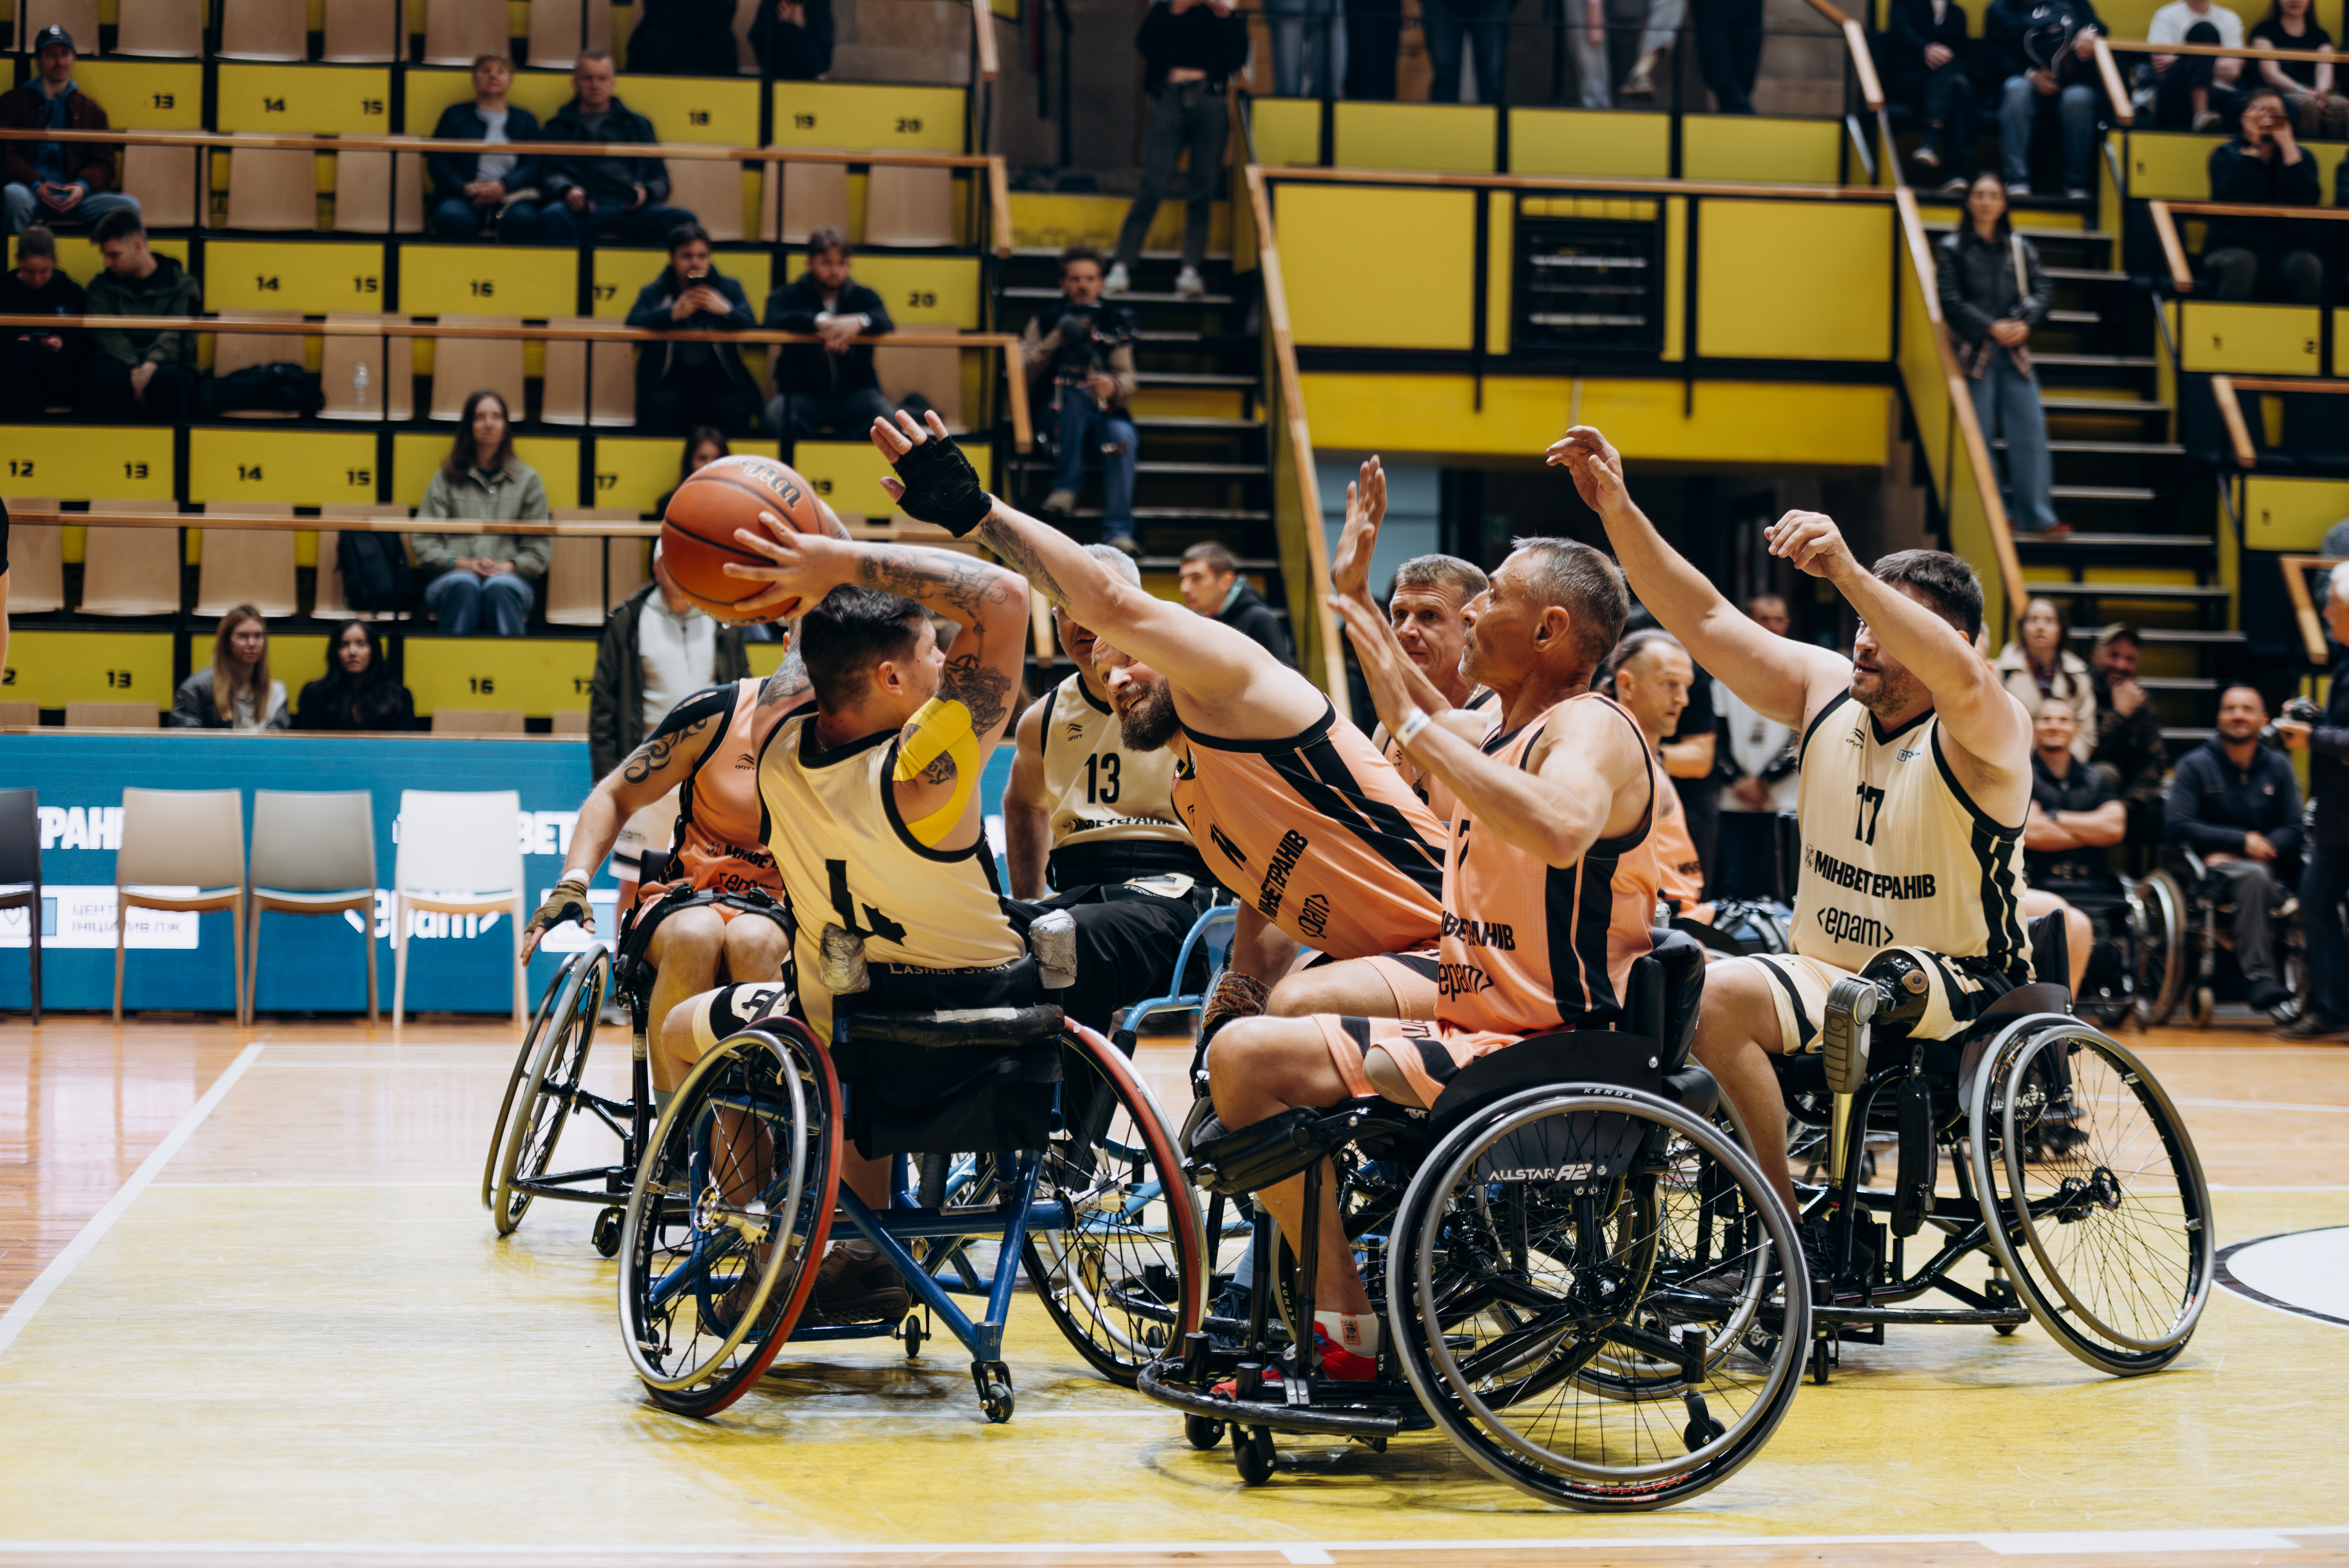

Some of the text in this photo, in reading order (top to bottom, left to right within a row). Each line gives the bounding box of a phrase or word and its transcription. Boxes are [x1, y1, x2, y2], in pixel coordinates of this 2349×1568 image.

[152, 94, 175, 109] 13
[263, 99, 286, 113] 14
[363, 100, 383, 115] 15
[896, 119, 922, 133] 20
[256, 276, 280, 291] 14
[355, 277, 377, 292] 15
[594, 287, 617, 301] 17
[908, 293, 936, 308] 20
[9, 460, 34, 477] 12
[125, 464, 149, 480] 13
[238, 465, 262, 482] 14
[347, 469, 370, 486] 15
[596, 476, 617, 489] 17
[107, 671, 132, 688] 13
[470, 678, 494, 694] 16
[1084, 753, 1121, 804] 13
[1855, 781, 1885, 846] 17
[1584, 1088, 1633, 1099] KENDA
[1488, 1164, 1592, 1181] ALLSTAR A2
[635, 1146, 669, 1267] SPINEGY
[1281, 1281, 1296, 1321] KENDA
